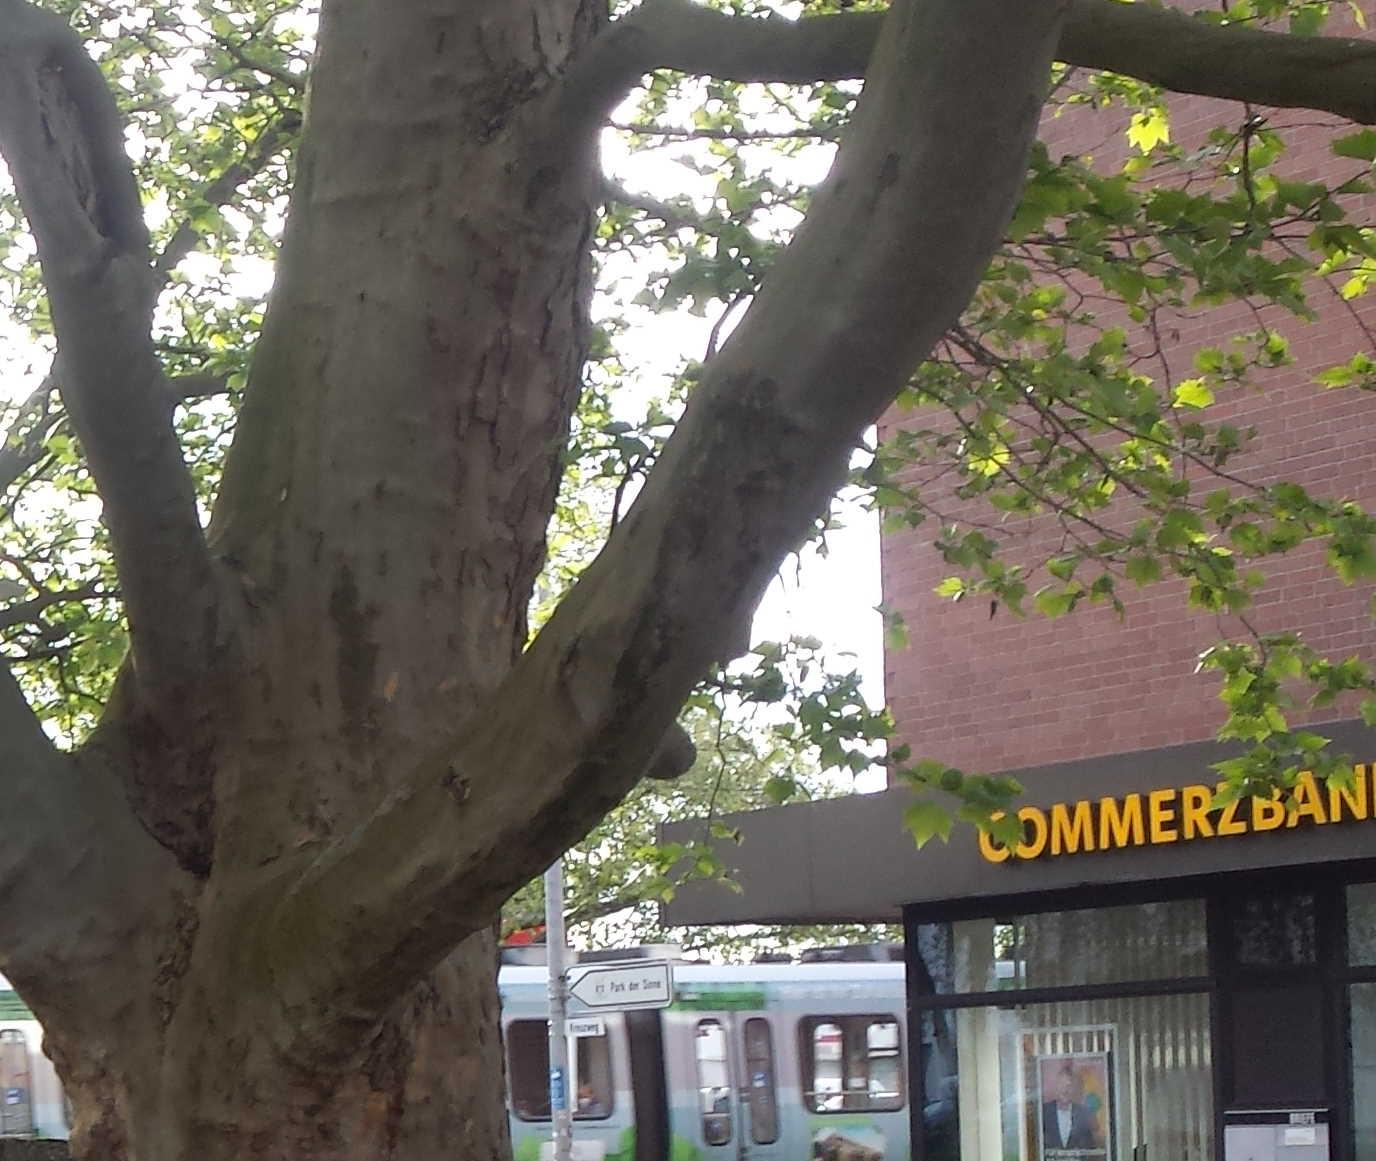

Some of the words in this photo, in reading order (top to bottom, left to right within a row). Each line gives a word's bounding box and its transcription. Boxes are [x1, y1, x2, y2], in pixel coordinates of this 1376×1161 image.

[978, 762, 1376, 864] COMMERZBAN
[610, 981, 625, 993] Park
[629, 981, 640, 992] der
